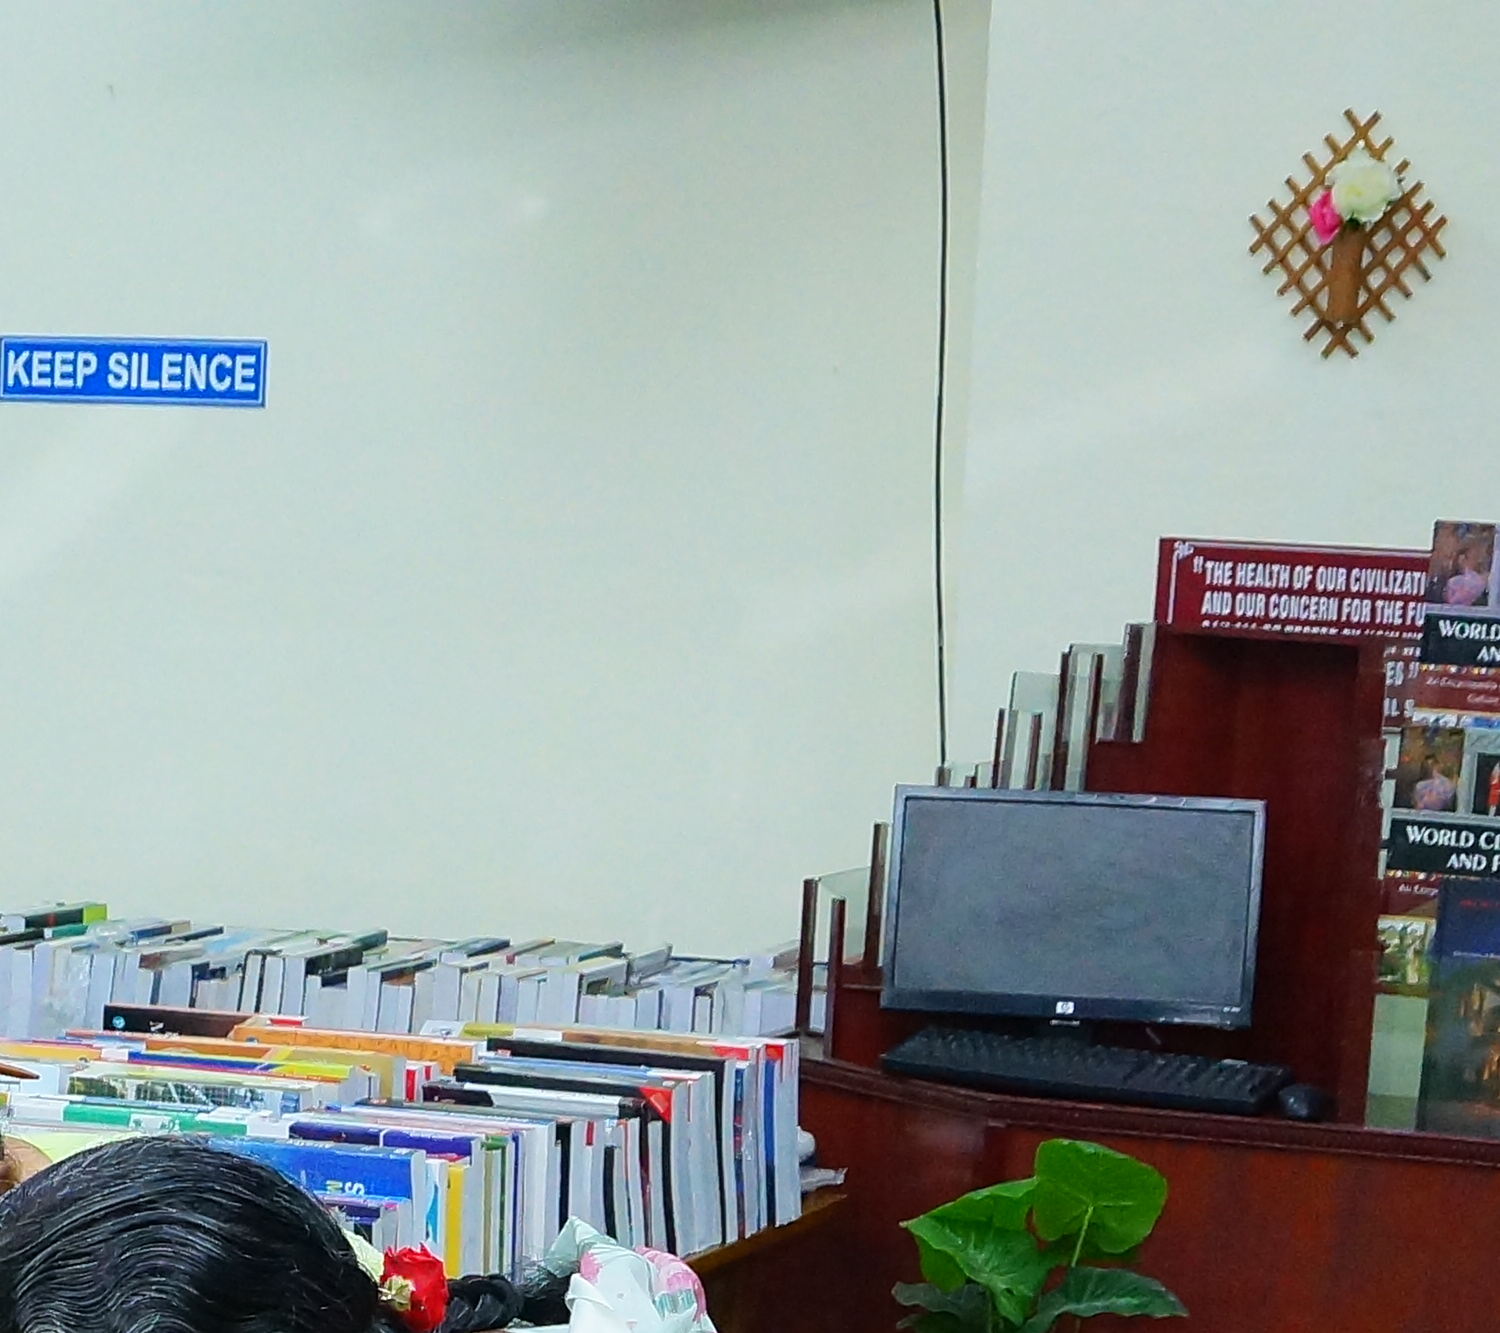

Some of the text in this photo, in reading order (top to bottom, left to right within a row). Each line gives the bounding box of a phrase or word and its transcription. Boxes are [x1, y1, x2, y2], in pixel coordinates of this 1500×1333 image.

[7, 350, 256, 391] KEEP SILENCE
[1235, 561, 1290, 589] HEALTH
[1293, 565, 1313, 590] OF
[1316, 566, 1347, 591] OUR
[1201, 591, 1232, 616] AND
[1235, 592, 1265, 617] OUR
[1268, 594, 1338, 621] CONCERN
[1341, 598, 1371, 623] FOR
[1375, 601, 1403, 625] THE
[1405, 824, 1474, 849] WORLD
[1446, 852, 1487, 872] AND
